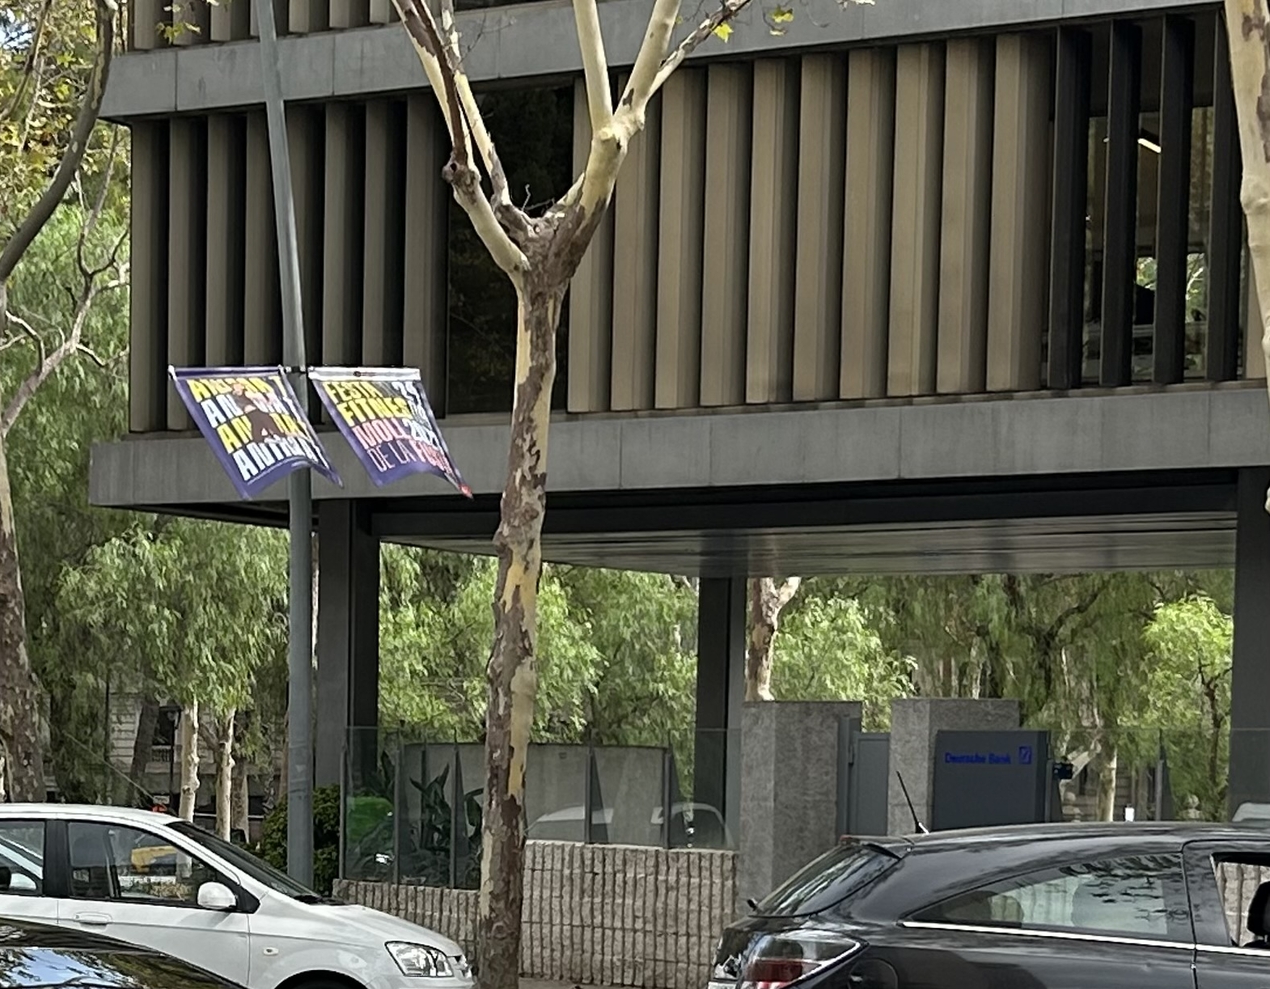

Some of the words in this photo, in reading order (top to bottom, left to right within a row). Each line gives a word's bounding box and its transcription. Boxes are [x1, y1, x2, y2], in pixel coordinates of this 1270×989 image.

[322, 381, 383, 403] FESTA
[352, 417, 412, 449] MOLL
[367, 444, 395, 472] DE
[388, 439, 417, 464] LA
